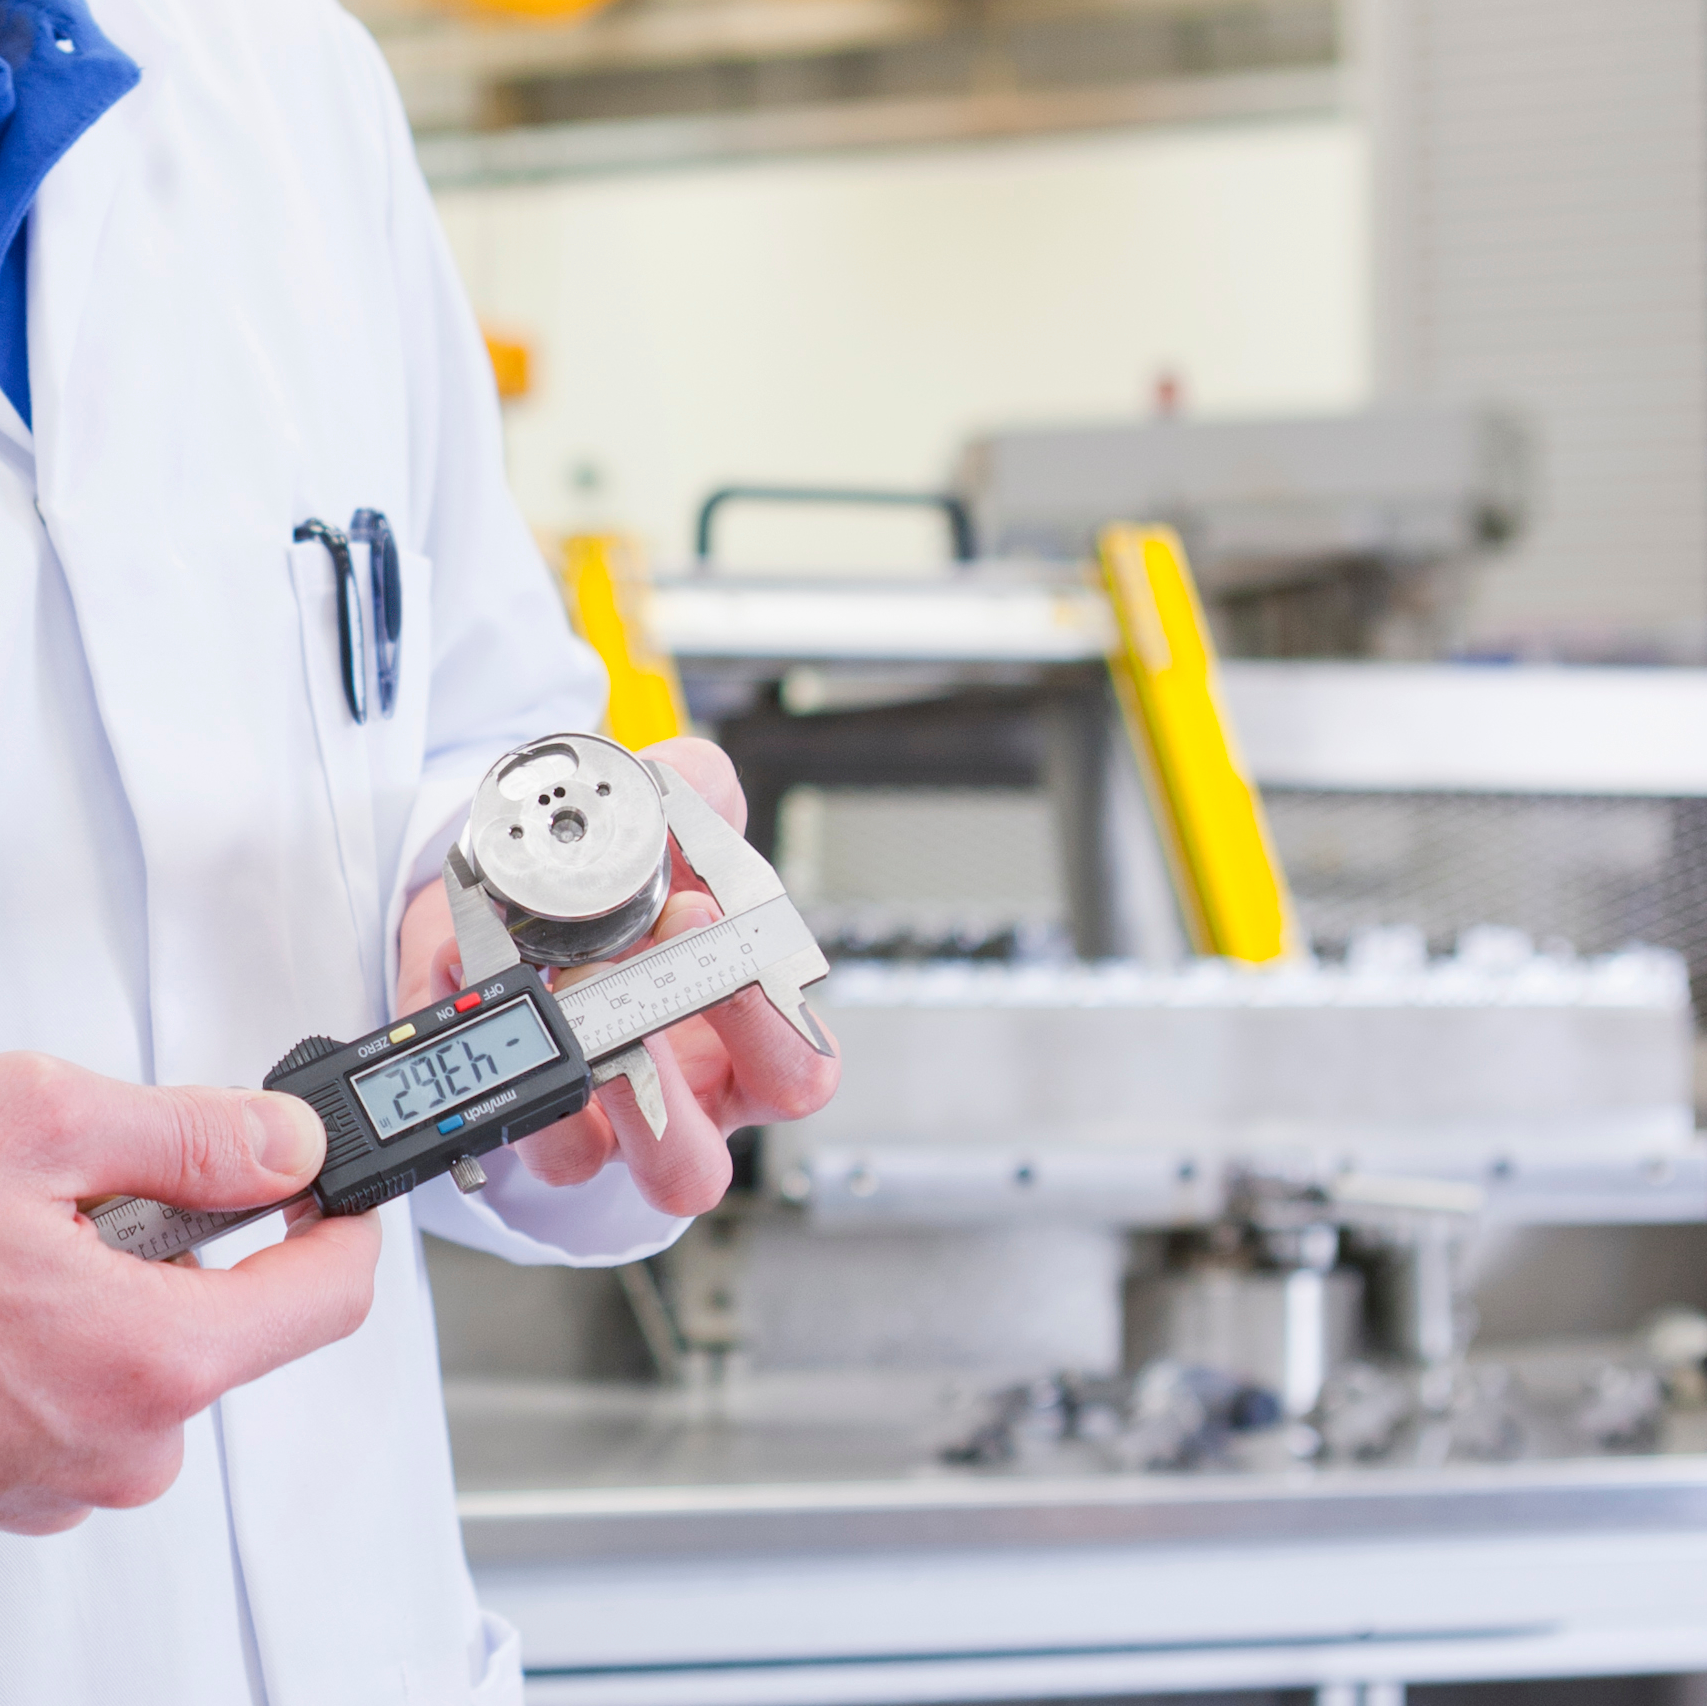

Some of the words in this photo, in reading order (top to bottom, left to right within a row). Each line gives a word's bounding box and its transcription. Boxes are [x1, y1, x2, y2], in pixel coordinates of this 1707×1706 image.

[741, 943, 753, 954] 0
[698, 953, 717, 967] 10
[654, 972, 676, 988] 20
[482, 982, 505, 1001] OFF
[610, 994, 632, 1009] 30
[638, 1001, 646, 1009] 1
[435, 1006, 456, 1022] ON
[357, 1034, 391, 1059] ZERO
[463, 1089, 517, 1122] mm/inch
[379, 1116, 391, 1129] in
[116, 1221, 145, 1241] 140
